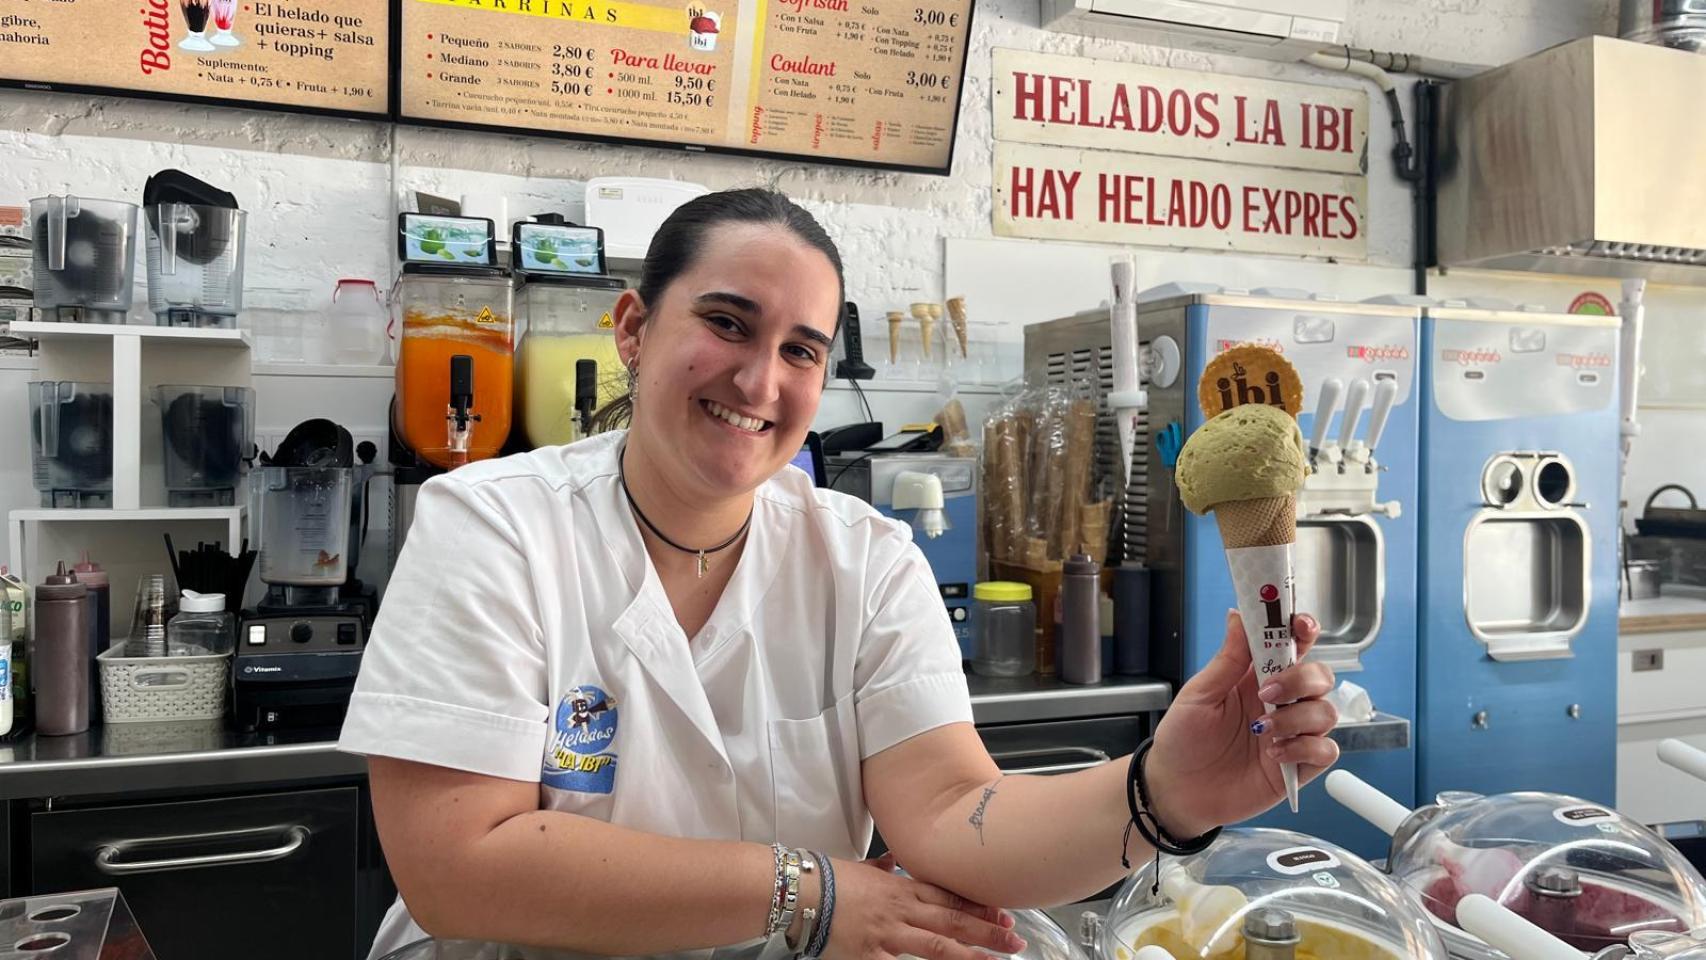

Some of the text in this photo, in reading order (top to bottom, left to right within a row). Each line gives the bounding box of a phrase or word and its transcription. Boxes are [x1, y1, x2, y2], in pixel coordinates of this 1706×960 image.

[1, 15, 41, 30] gibre,
[255, 3, 362, 28] El helado que
[780, 13, 796, 22] Con
[804, 16, 824, 26] Salsa
[861, 6, 959, 27] Solo 3,00 €
[334, 31, 374, 46] salsa
[779, 24, 795, 32] Con
[796, 26, 817, 35] Fruta
[876, 26, 890, 34] Con
[892, 27, 909, 37] Nata
[274, 40, 334, 60] topping
[440, 33, 489, 49] Pequeño
[505, 42, 542, 52] SABORES
[552, 45, 582, 60] 2,80
[586, 48, 595, 61] €
[875, 36, 889, 45] Con
[891, 37, 920, 49] Topping
[873, 47, 888, 55] Con
[890, 48, 915, 58] Helado
[197, 57, 268, 72] Suplemento:
[440, 53, 489, 68] Mediano
[503, 60, 541, 70] SABORES
[552, 63, 581, 78] 3,80
[585, 67, 594, 79] €
[611, 49, 716, 75] Para llevar
[771, 53, 951, 89] Coulant Solo 3,00 €
[207, 72, 234, 83] Nata
[250, 77, 273, 88] 0,75
[297, 81, 327, 93] Fruta
[343, 88, 364, 97] 1,90
[440, 72, 481, 85] Grande
[503, 79, 540, 88] SABORES
[551, 80, 580, 96] 5,00
[584, 84, 593, 96] €
[617, 73, 635, 83] 500
[675, 76, 703, 91] 9,50
[707, 80, 716, 91] €
[775, 76, 790, 85] Con
[791, 78, 809, 87] Nata
[617, 89, 640, 99] 1000
[667, 91, 701, 106] 15,50
[706, 95, 714, 107] €
[773, 88, 788, 97] Con
[790, 89, 817, 99] Helado
[868, 87, 883, 95] Con
[884, 89, 904, 98] Fruta
[1012, 71, 1354, 154] HELADOS LA IBI
[1011, 165, 1359, 240] HAY HELADO EXPRES
[551, 727, 614, 754] Helados
